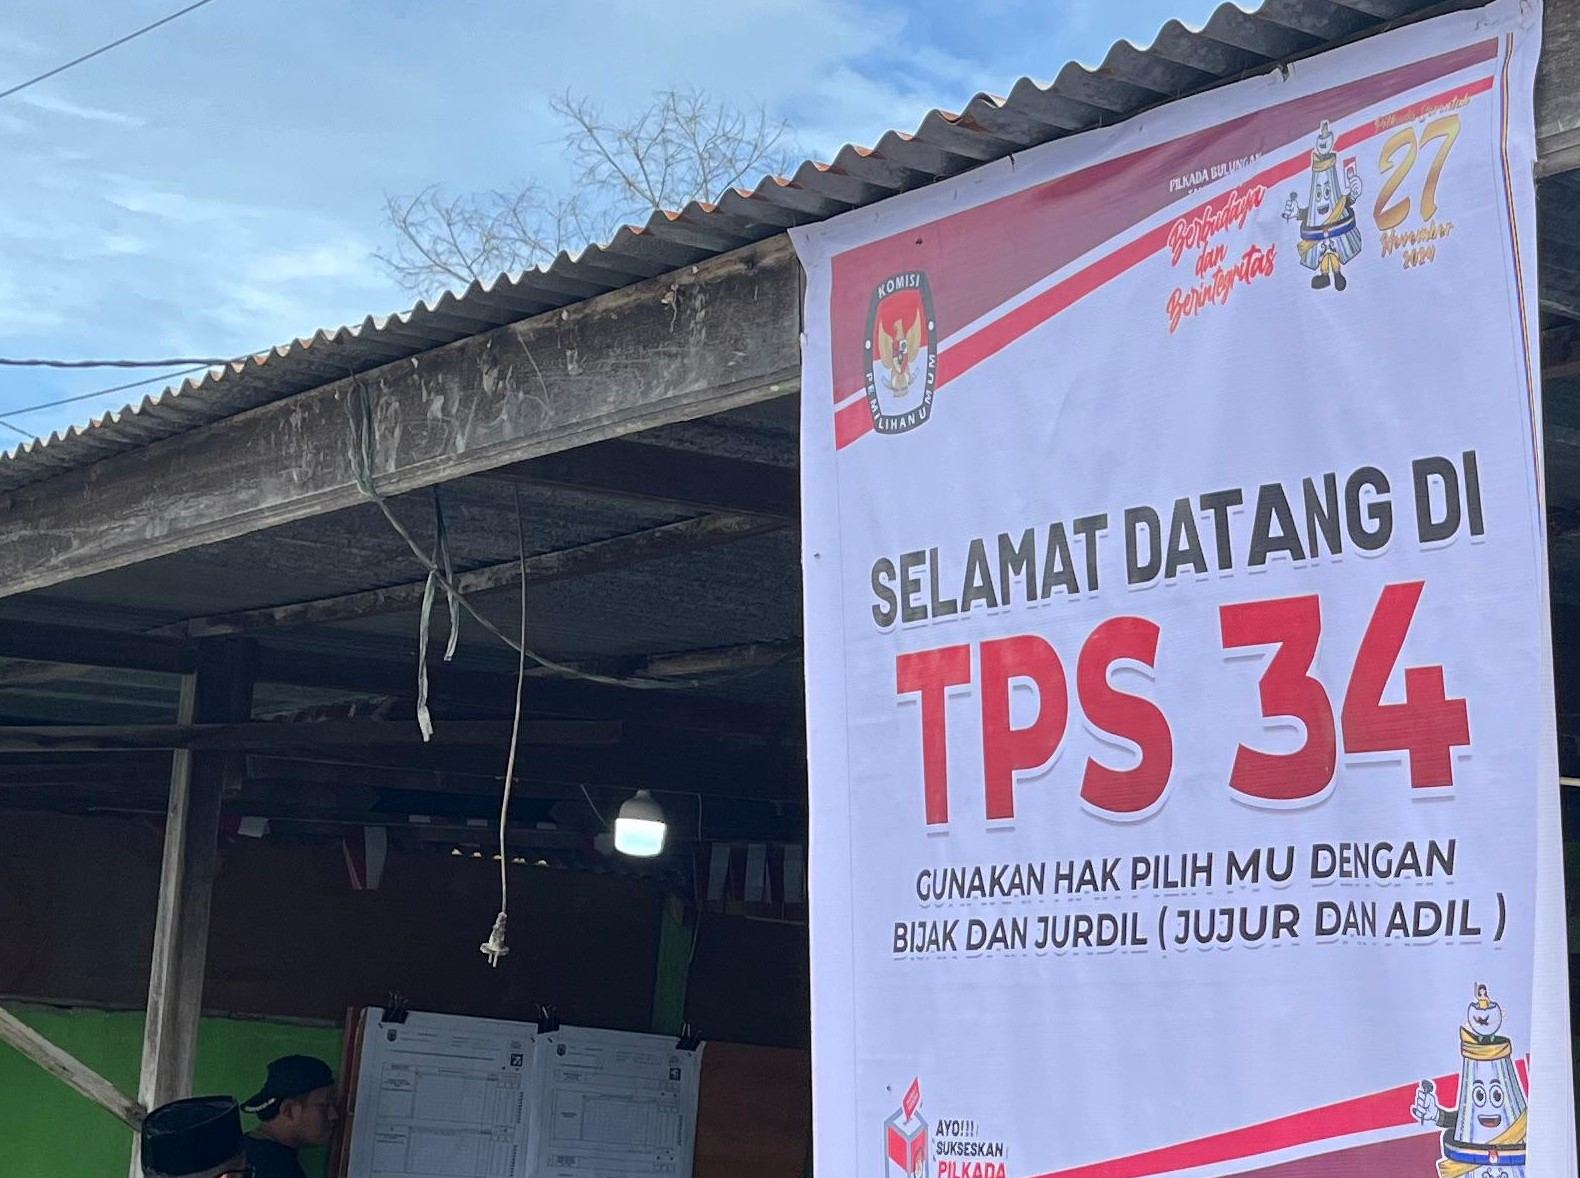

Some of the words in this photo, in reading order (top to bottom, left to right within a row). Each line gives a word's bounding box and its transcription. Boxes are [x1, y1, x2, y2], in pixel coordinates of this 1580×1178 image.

[1169, 168, 1209, 193] PILKADA
[1373, 114, 1462, 232] 27
[1167, 185, 1268, 267] Berbudaya
[1379, 221, 1454, 259] November
[877, 272, 921, 300] KOMISI
[1166, 243, 1278, 335] Berintegritas
[1195, 243, 1226, 278] dan
[865, 372, 917, 431] PEMILIHAN
[917, 353, 937, 420] UMUM
[870, 513, 1108, 628] SELAMAT
[1124, 465, 1393, 586] DATANG
[1412, 449, 1485, 545] DI
[896, 616, 1173, 825] TPS
[1219, 580, 1472, 801] 34
[916, 861, 1046, 902] GUNAKAN
[1053, 857, 1122, 895] HAK
[1130, 851, 1213, 891] PILIH
[1226, 845, 1295, 885] MU
[1310, 838, 1457, 879] DENGAN
[893, 919, 960, 953] BIJAK
[965, 916, 1028, 951] DAN
[1034, 911, 1149, 951] JURDIL
[1315, 900, 1376, 938] DAN
[935, 1141, 1004, 1158] SUKSESKAN
